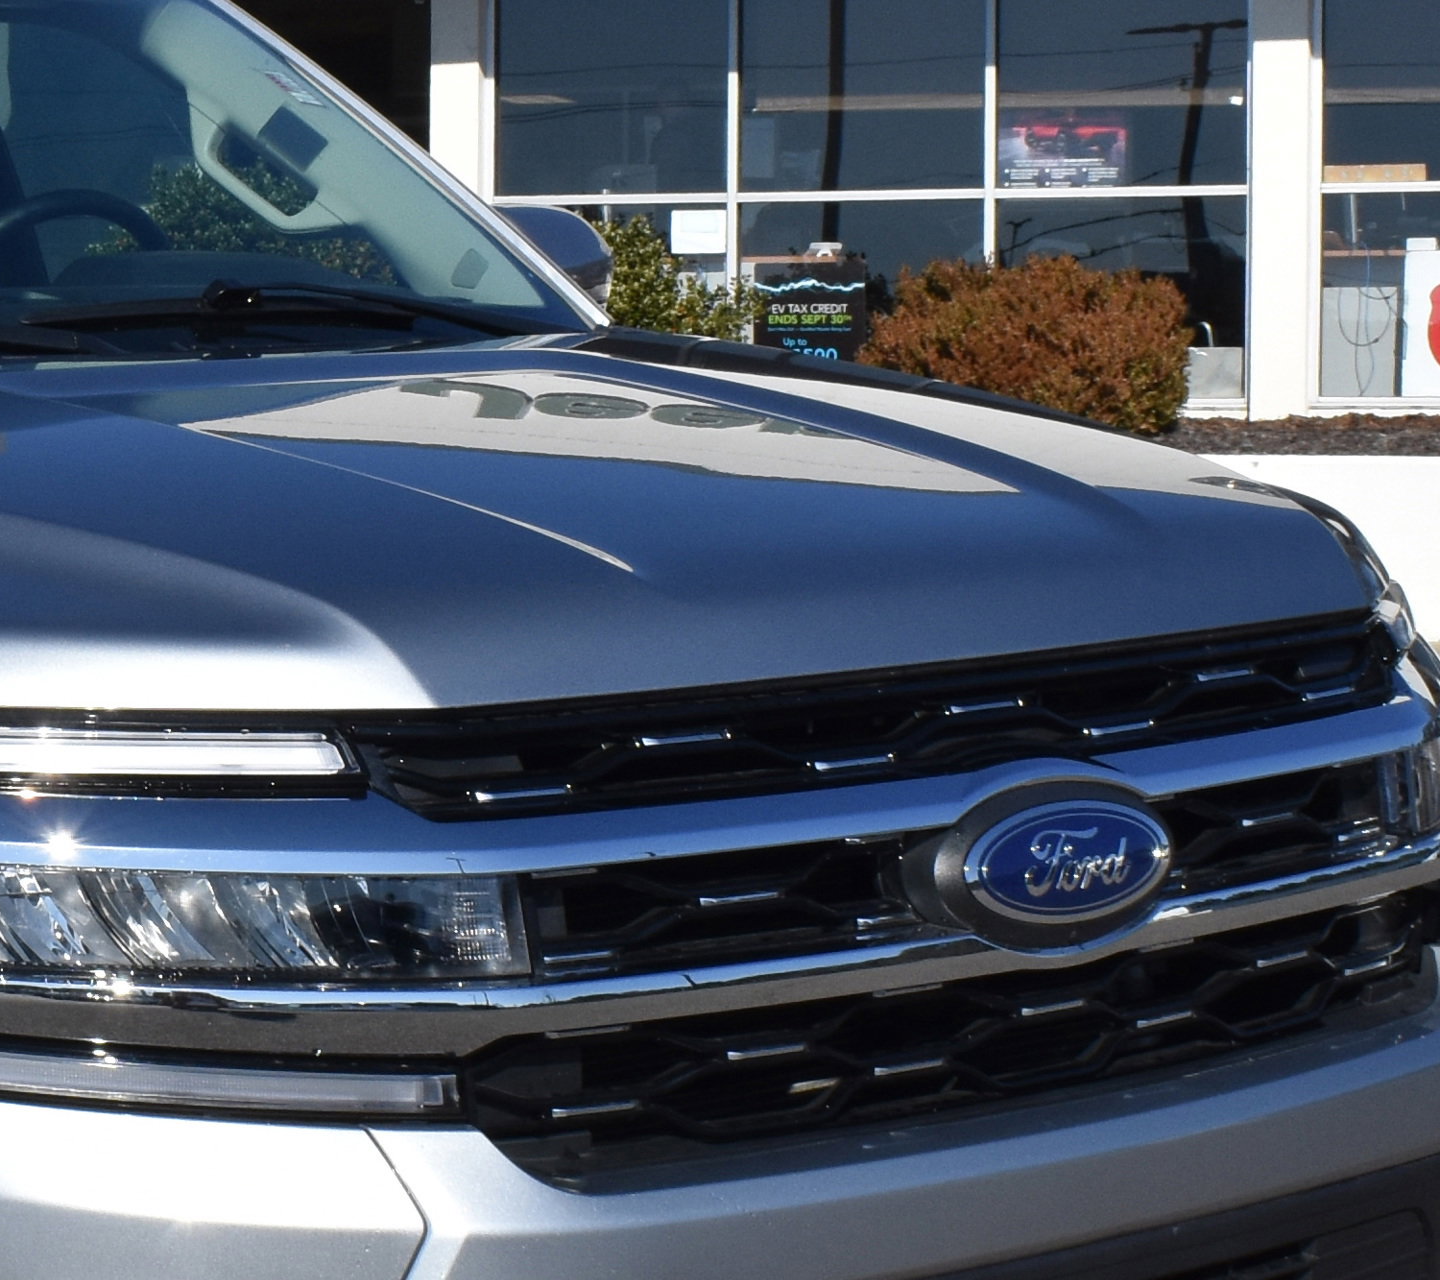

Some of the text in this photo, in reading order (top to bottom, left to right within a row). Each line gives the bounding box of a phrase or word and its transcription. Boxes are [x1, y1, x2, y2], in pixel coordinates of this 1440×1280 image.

[771, 303, 849, 314] EV TAX CREDIT
[768, 314, 798, 325] ENDS
[801, 314, 827, 325] SEPT
[782, 338, 808, 347] Up to
[1024, 826, 1129, 897] Ford
